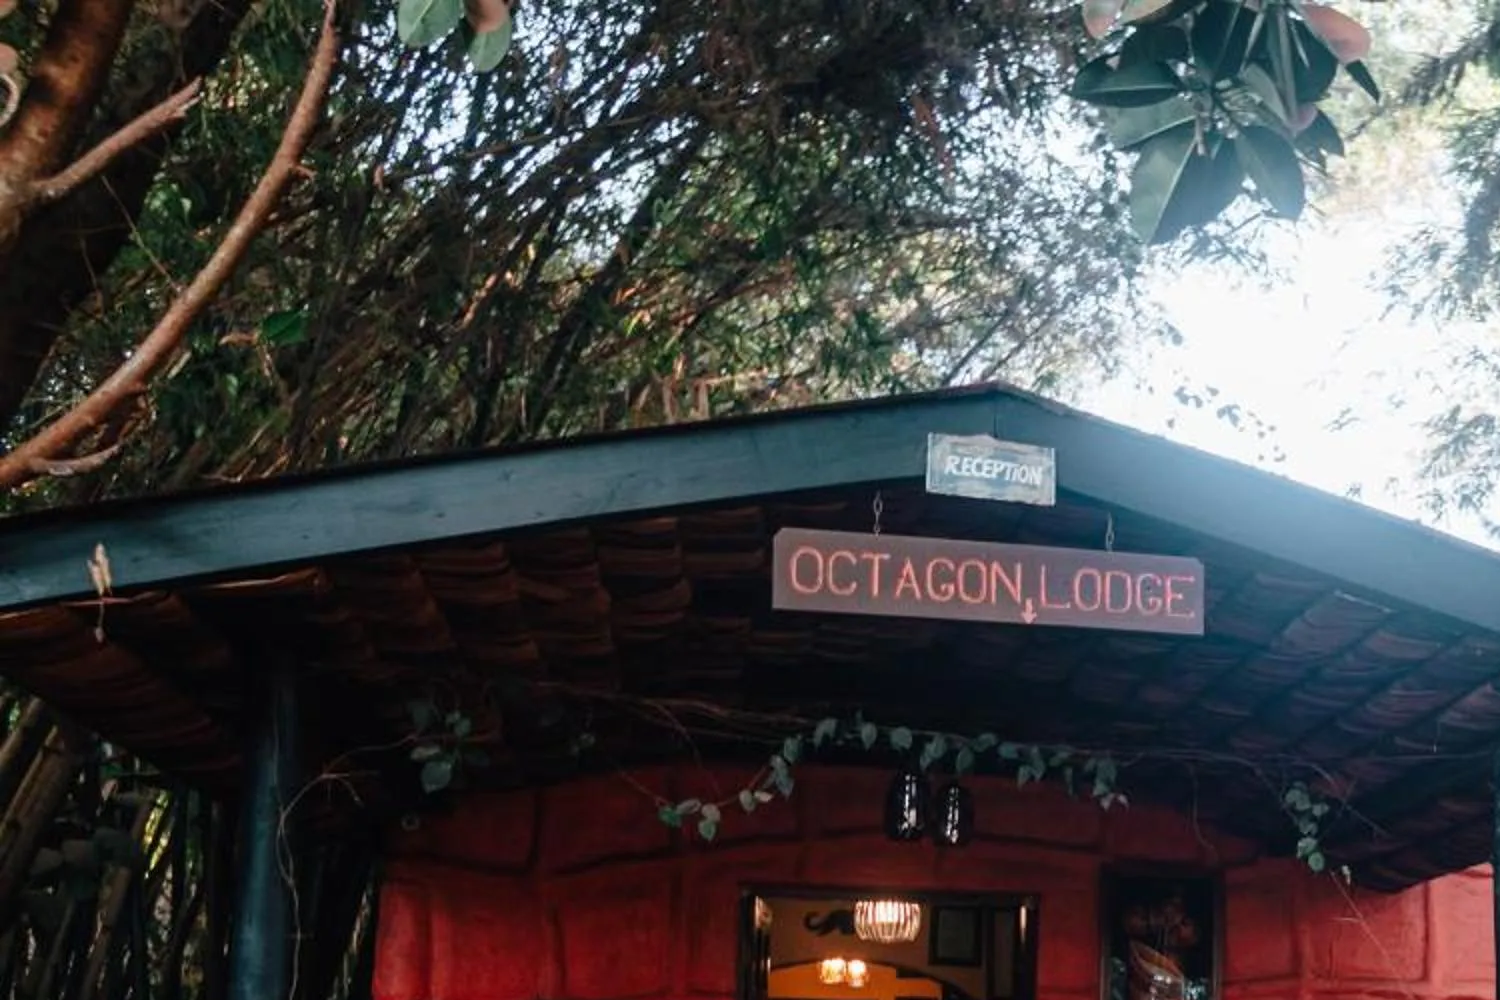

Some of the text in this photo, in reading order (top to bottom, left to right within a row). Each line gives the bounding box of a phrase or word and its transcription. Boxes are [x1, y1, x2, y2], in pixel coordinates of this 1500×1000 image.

[943, 455, 1043, 485] RECEPTION
[789, 546, 1196, 619] OCTAGON LODGE
